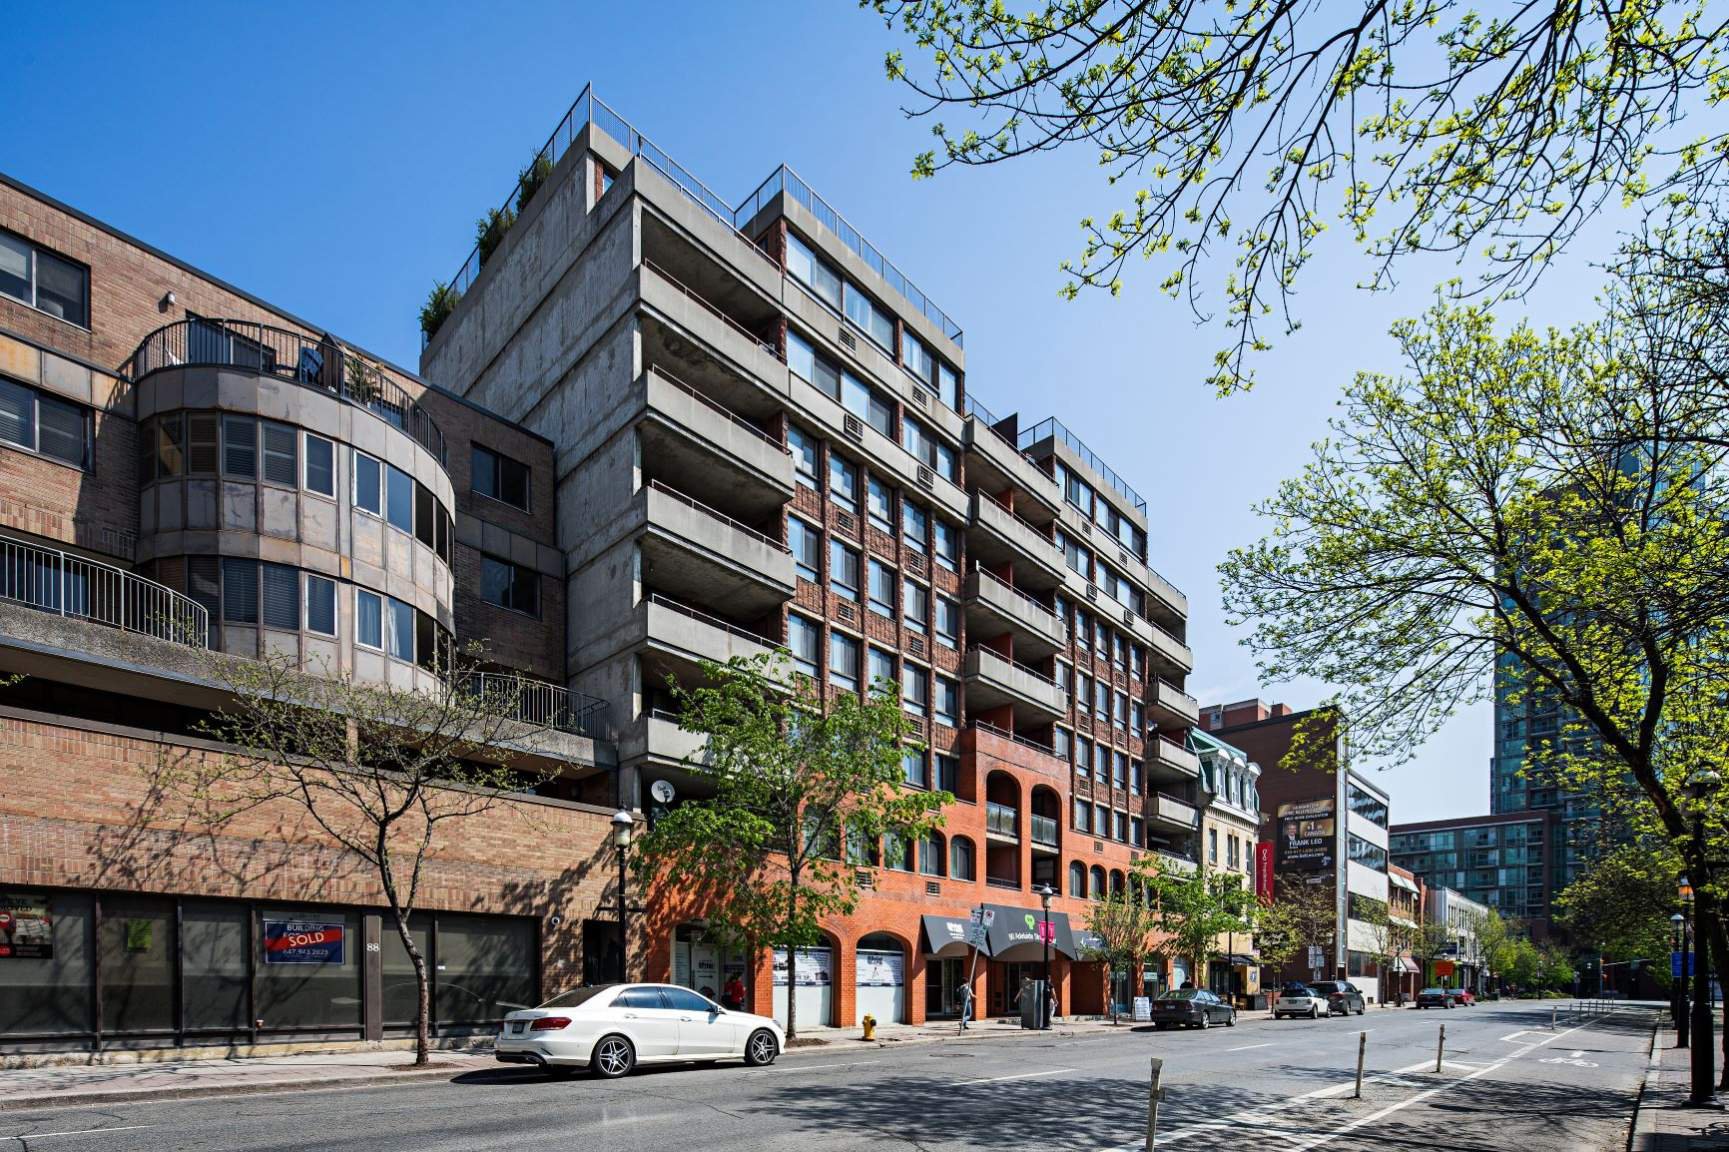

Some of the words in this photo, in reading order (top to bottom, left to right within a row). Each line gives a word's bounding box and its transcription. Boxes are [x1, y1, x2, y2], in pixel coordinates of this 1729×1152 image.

[1289, 839, 1309, 847] FRANK
[287, 923, 325, 931] BUILDING
[288, 932, 325, 947] SOLD
[366, 942, 380, 952] 88
